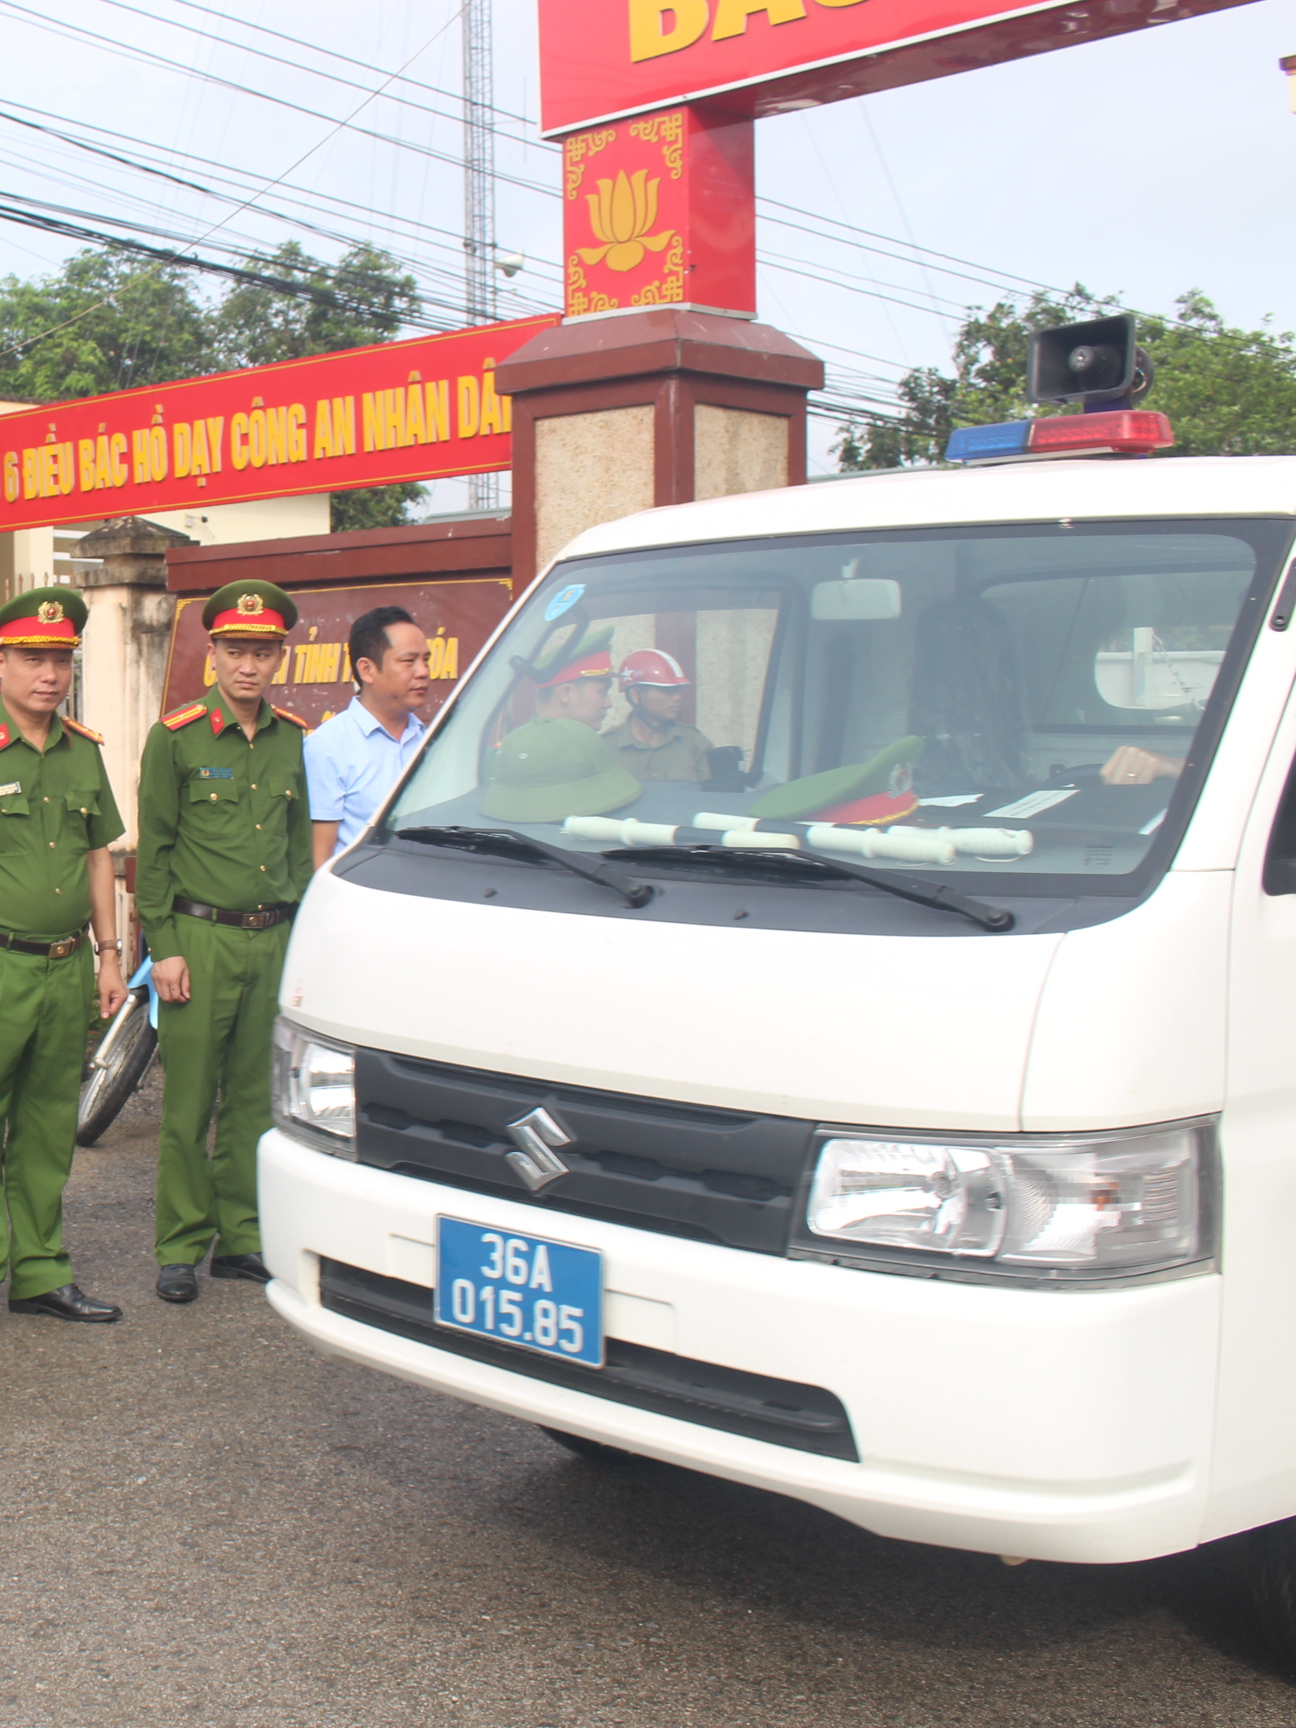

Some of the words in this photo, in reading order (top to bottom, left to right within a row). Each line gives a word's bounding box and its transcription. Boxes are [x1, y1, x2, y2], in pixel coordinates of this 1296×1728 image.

[4, 451, 19, 503] 6
[22, 423, 75, 501] ĐIỀU
[78, 422, 129, 493] BÁC
[132, 404, 168, 485] HỒ
[173, 415, 224, 488] DẠY
[230, 395, 307, 472] CÔNG
[313, 395, 356, 460] AN
[362, 370, 450, 453] NHÂN
[294, 626, 342, 685] TỈNH
[426, 626, 459, 681] ÓA
[480, 1232, 554, 1294] 36A
[451, 1278, 585, 1354] 015.85
